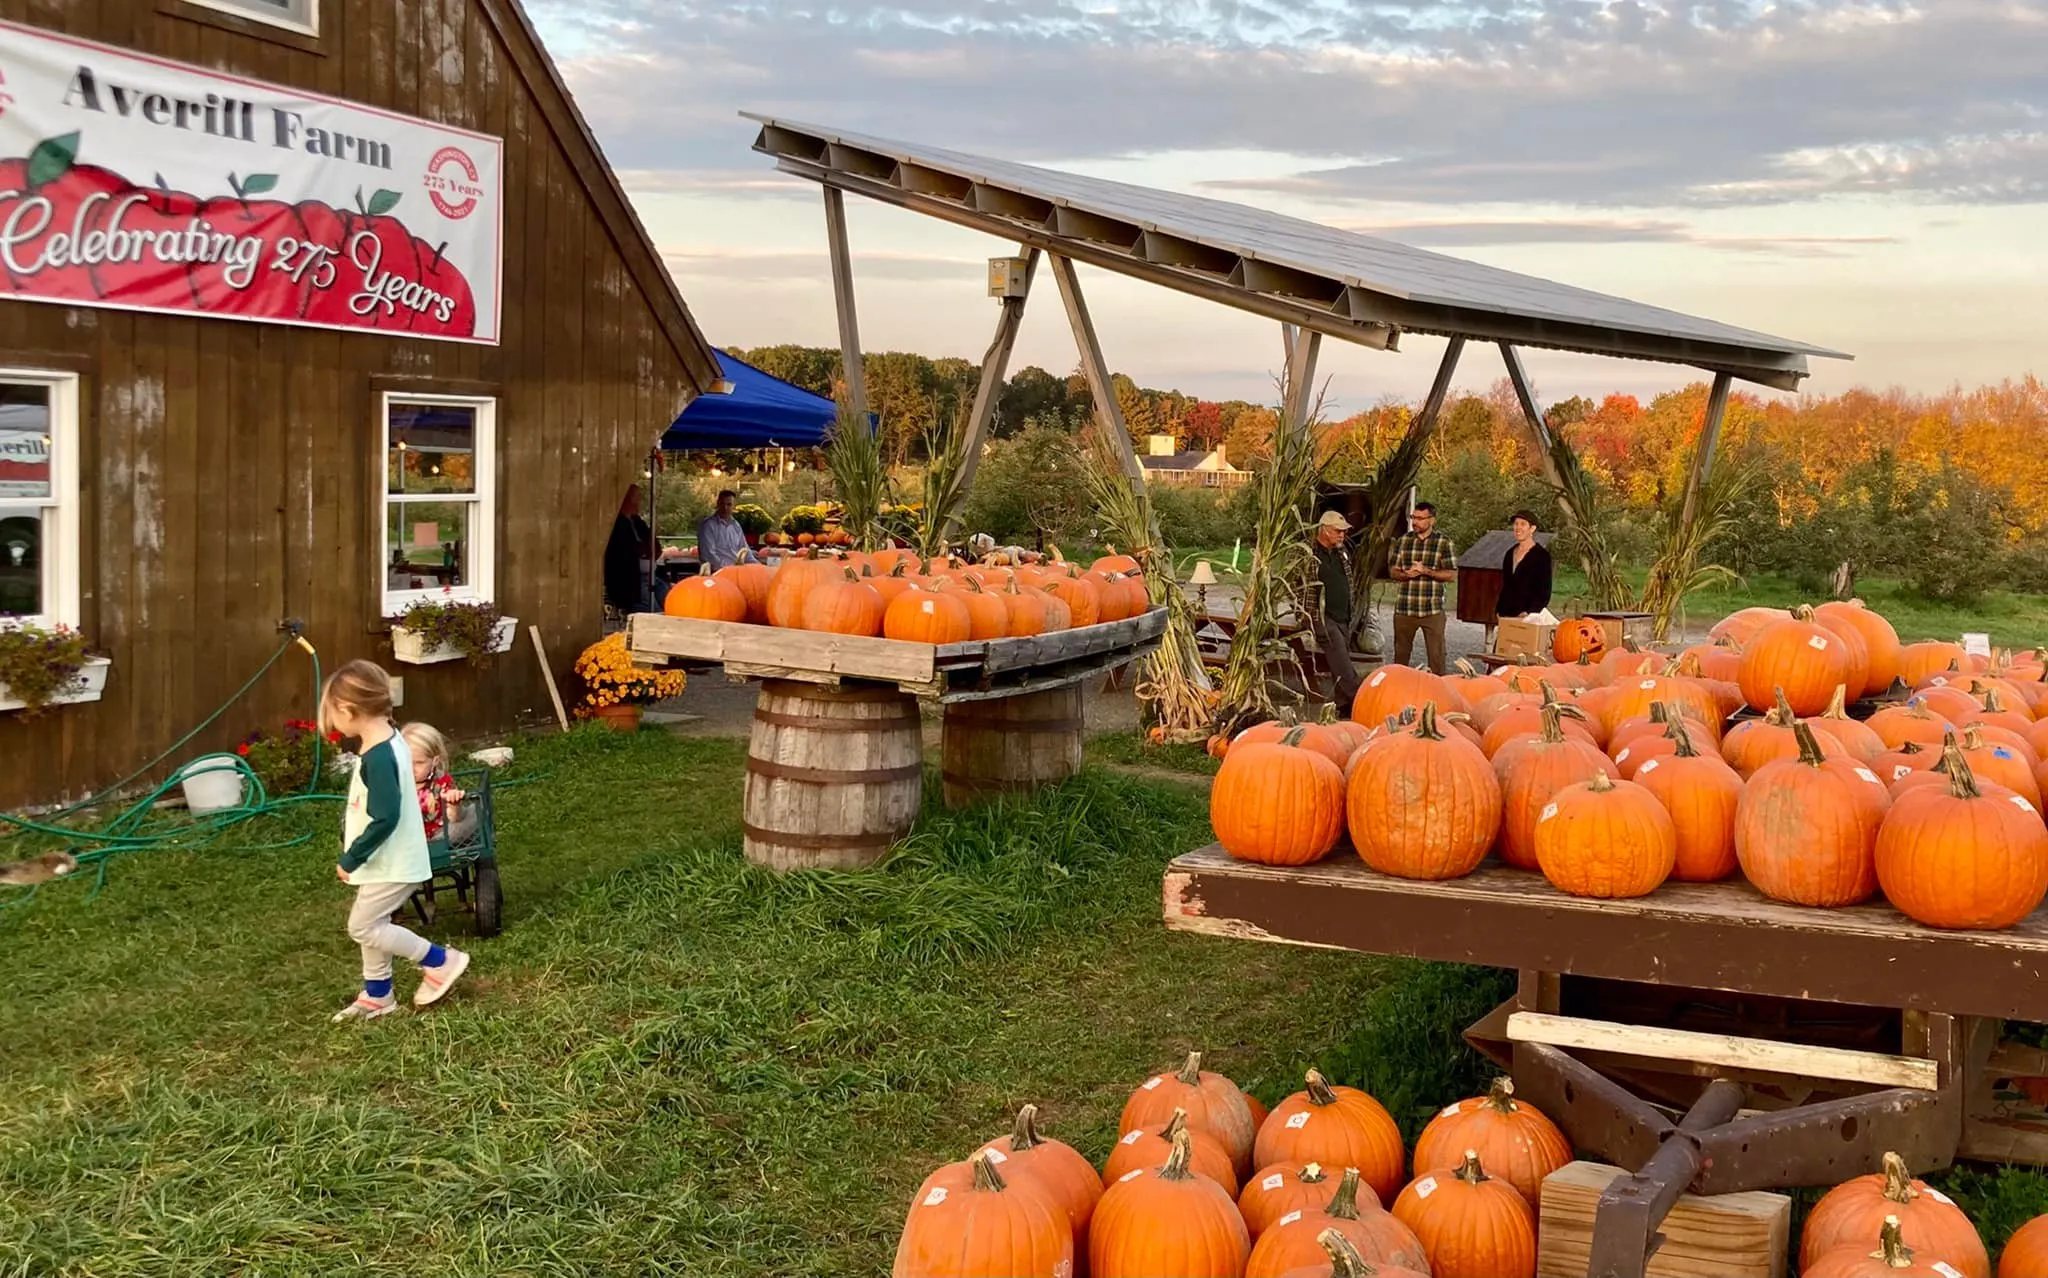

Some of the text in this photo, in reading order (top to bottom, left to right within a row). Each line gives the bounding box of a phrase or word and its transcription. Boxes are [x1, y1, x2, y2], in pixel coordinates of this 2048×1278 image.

[62, 64, 392, 171] Averill Farm
[423, 174, 484, 197] 275 Years
[0, 189, 457, 322] Celebrating 275 Years
[0, 438, 46, 455] erill
